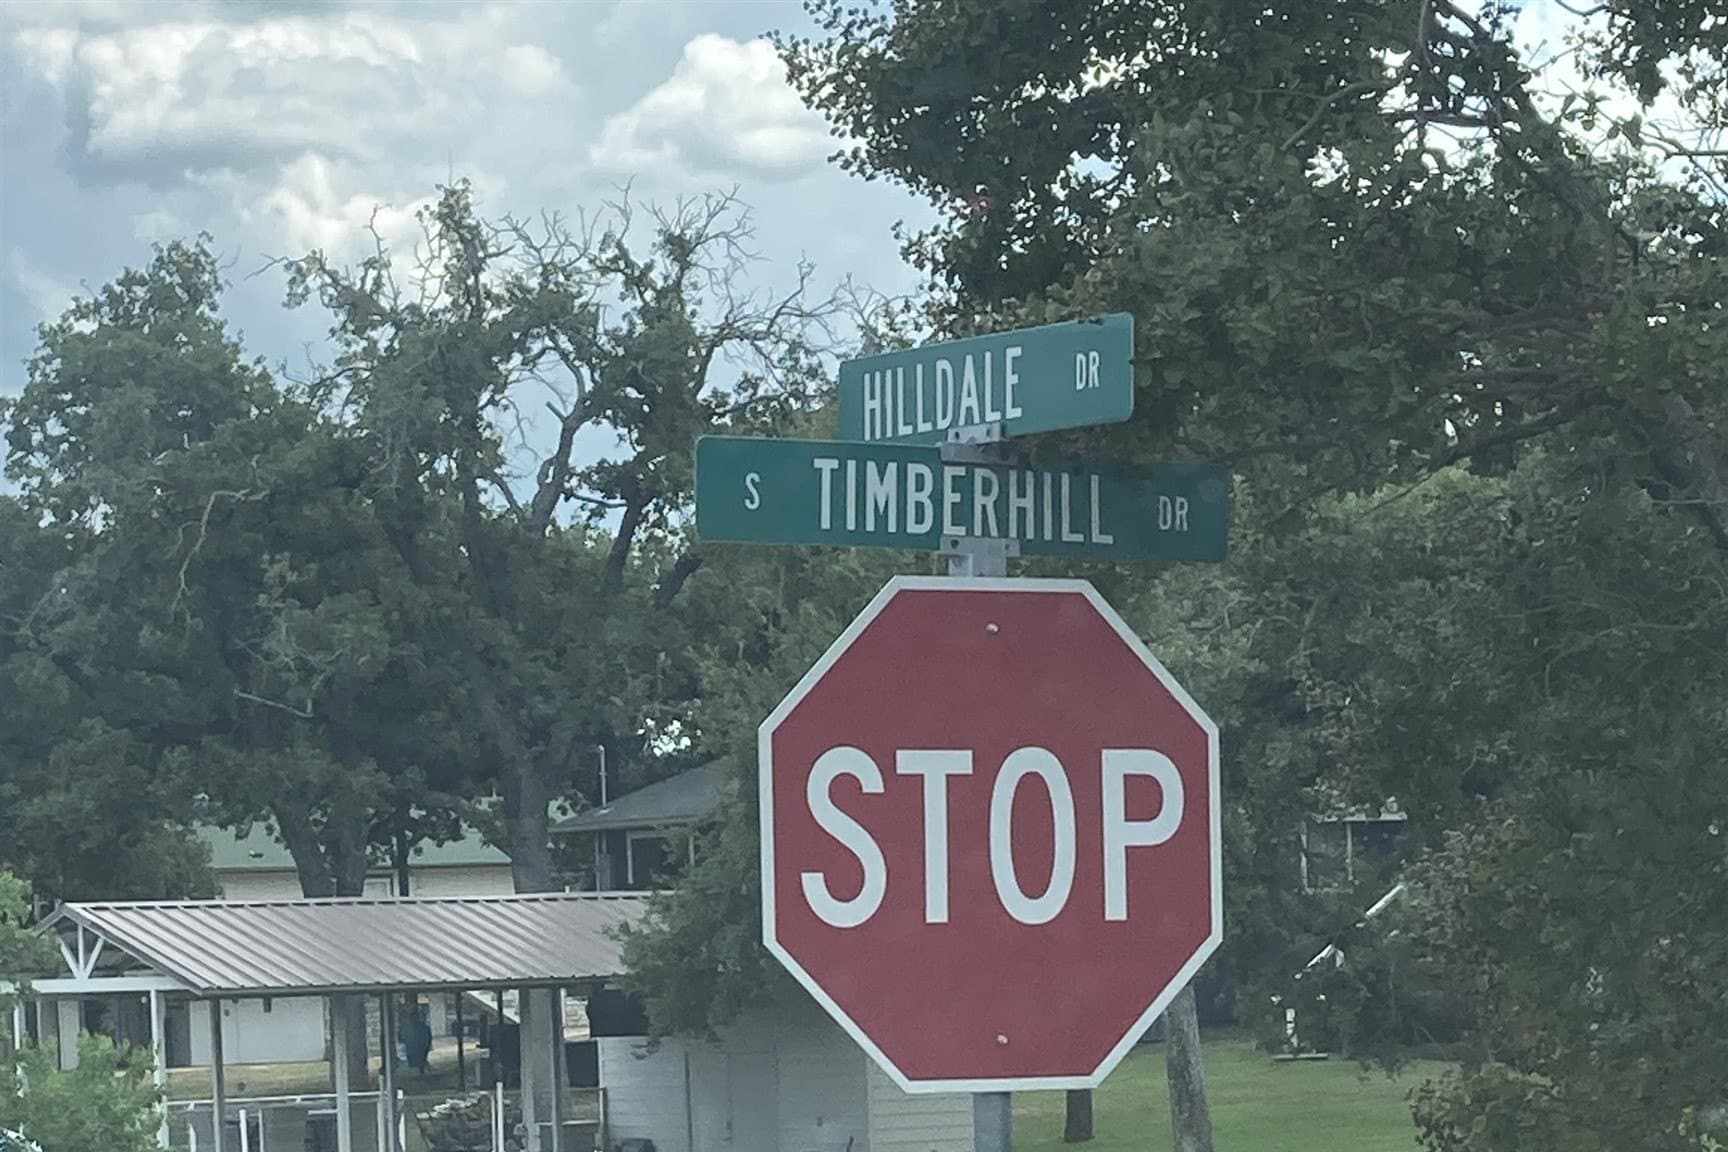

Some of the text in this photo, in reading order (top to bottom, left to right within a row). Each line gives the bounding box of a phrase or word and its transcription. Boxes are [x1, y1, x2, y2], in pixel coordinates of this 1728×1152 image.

[863, 346, 1100, 441] HILLDALE DR
[743, 458, 1189, 545] S TIMBERHILL DR
[801, 745, 1186, 929] STOP
